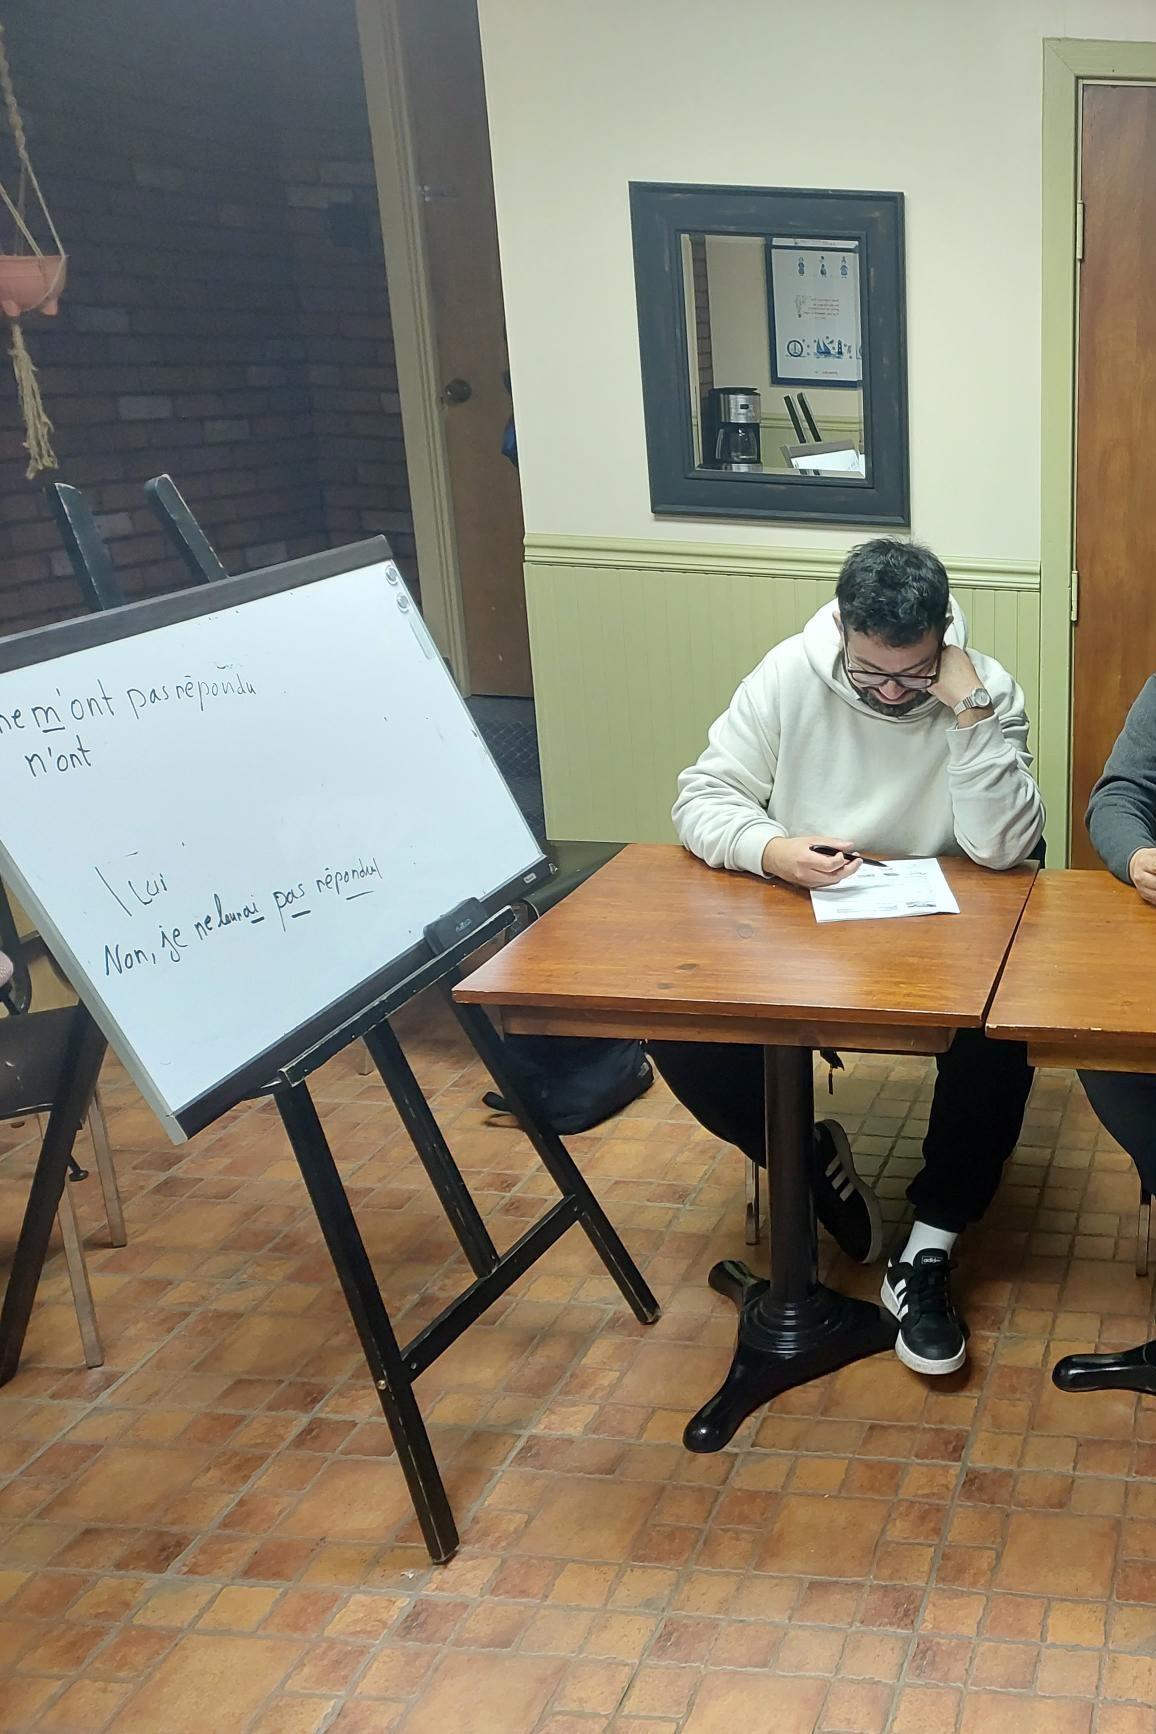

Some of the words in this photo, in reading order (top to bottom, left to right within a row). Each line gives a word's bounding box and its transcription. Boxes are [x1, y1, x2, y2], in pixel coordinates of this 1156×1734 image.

[127, 688, 170, 719] pas
[24, 734, 92, 777] n'ont
[159, 925, 188, 963] je
[272, 883, 306, 933] pas
